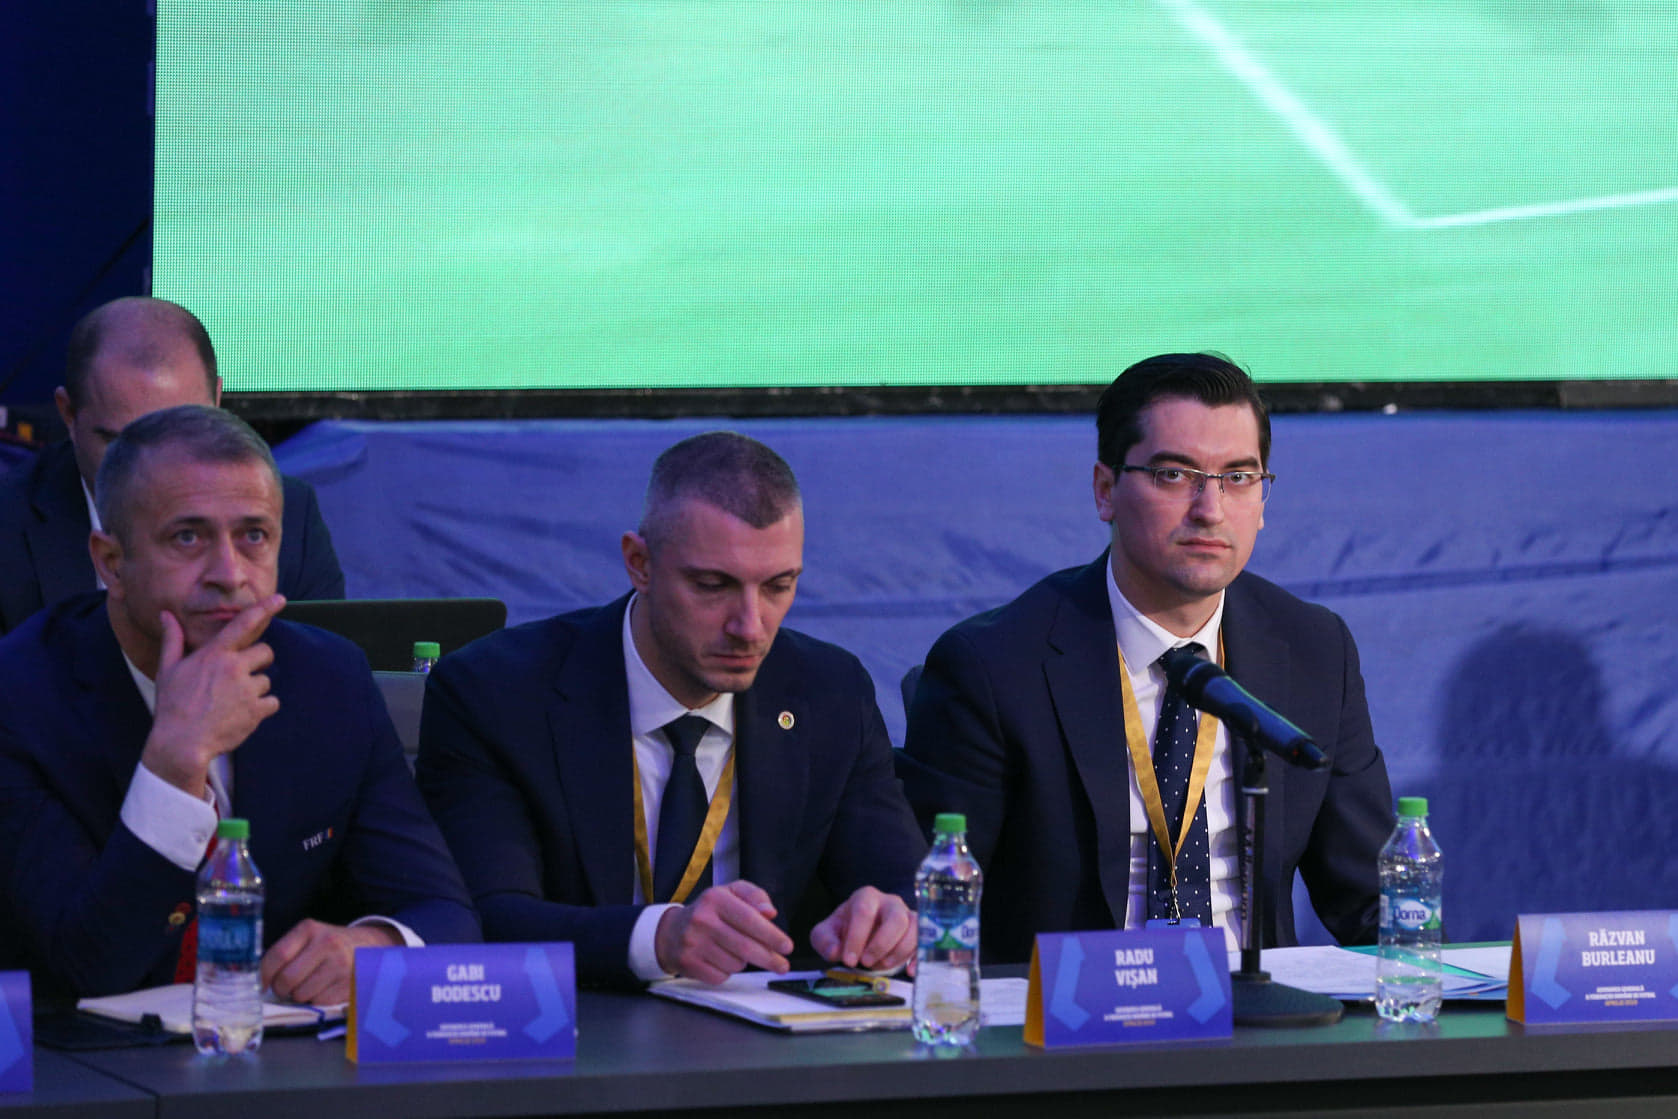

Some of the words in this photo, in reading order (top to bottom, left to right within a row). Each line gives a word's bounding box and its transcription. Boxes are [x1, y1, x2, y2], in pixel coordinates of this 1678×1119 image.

[1589, 928, 1646, 947] RĂZVAN
[1115, 948, 1155, 966] RADU
[1581, 949, 1656, 967] BURLEANU
[446, 963, 486, 982] GABI
[431, 984, 502, 1003] BODESCU
